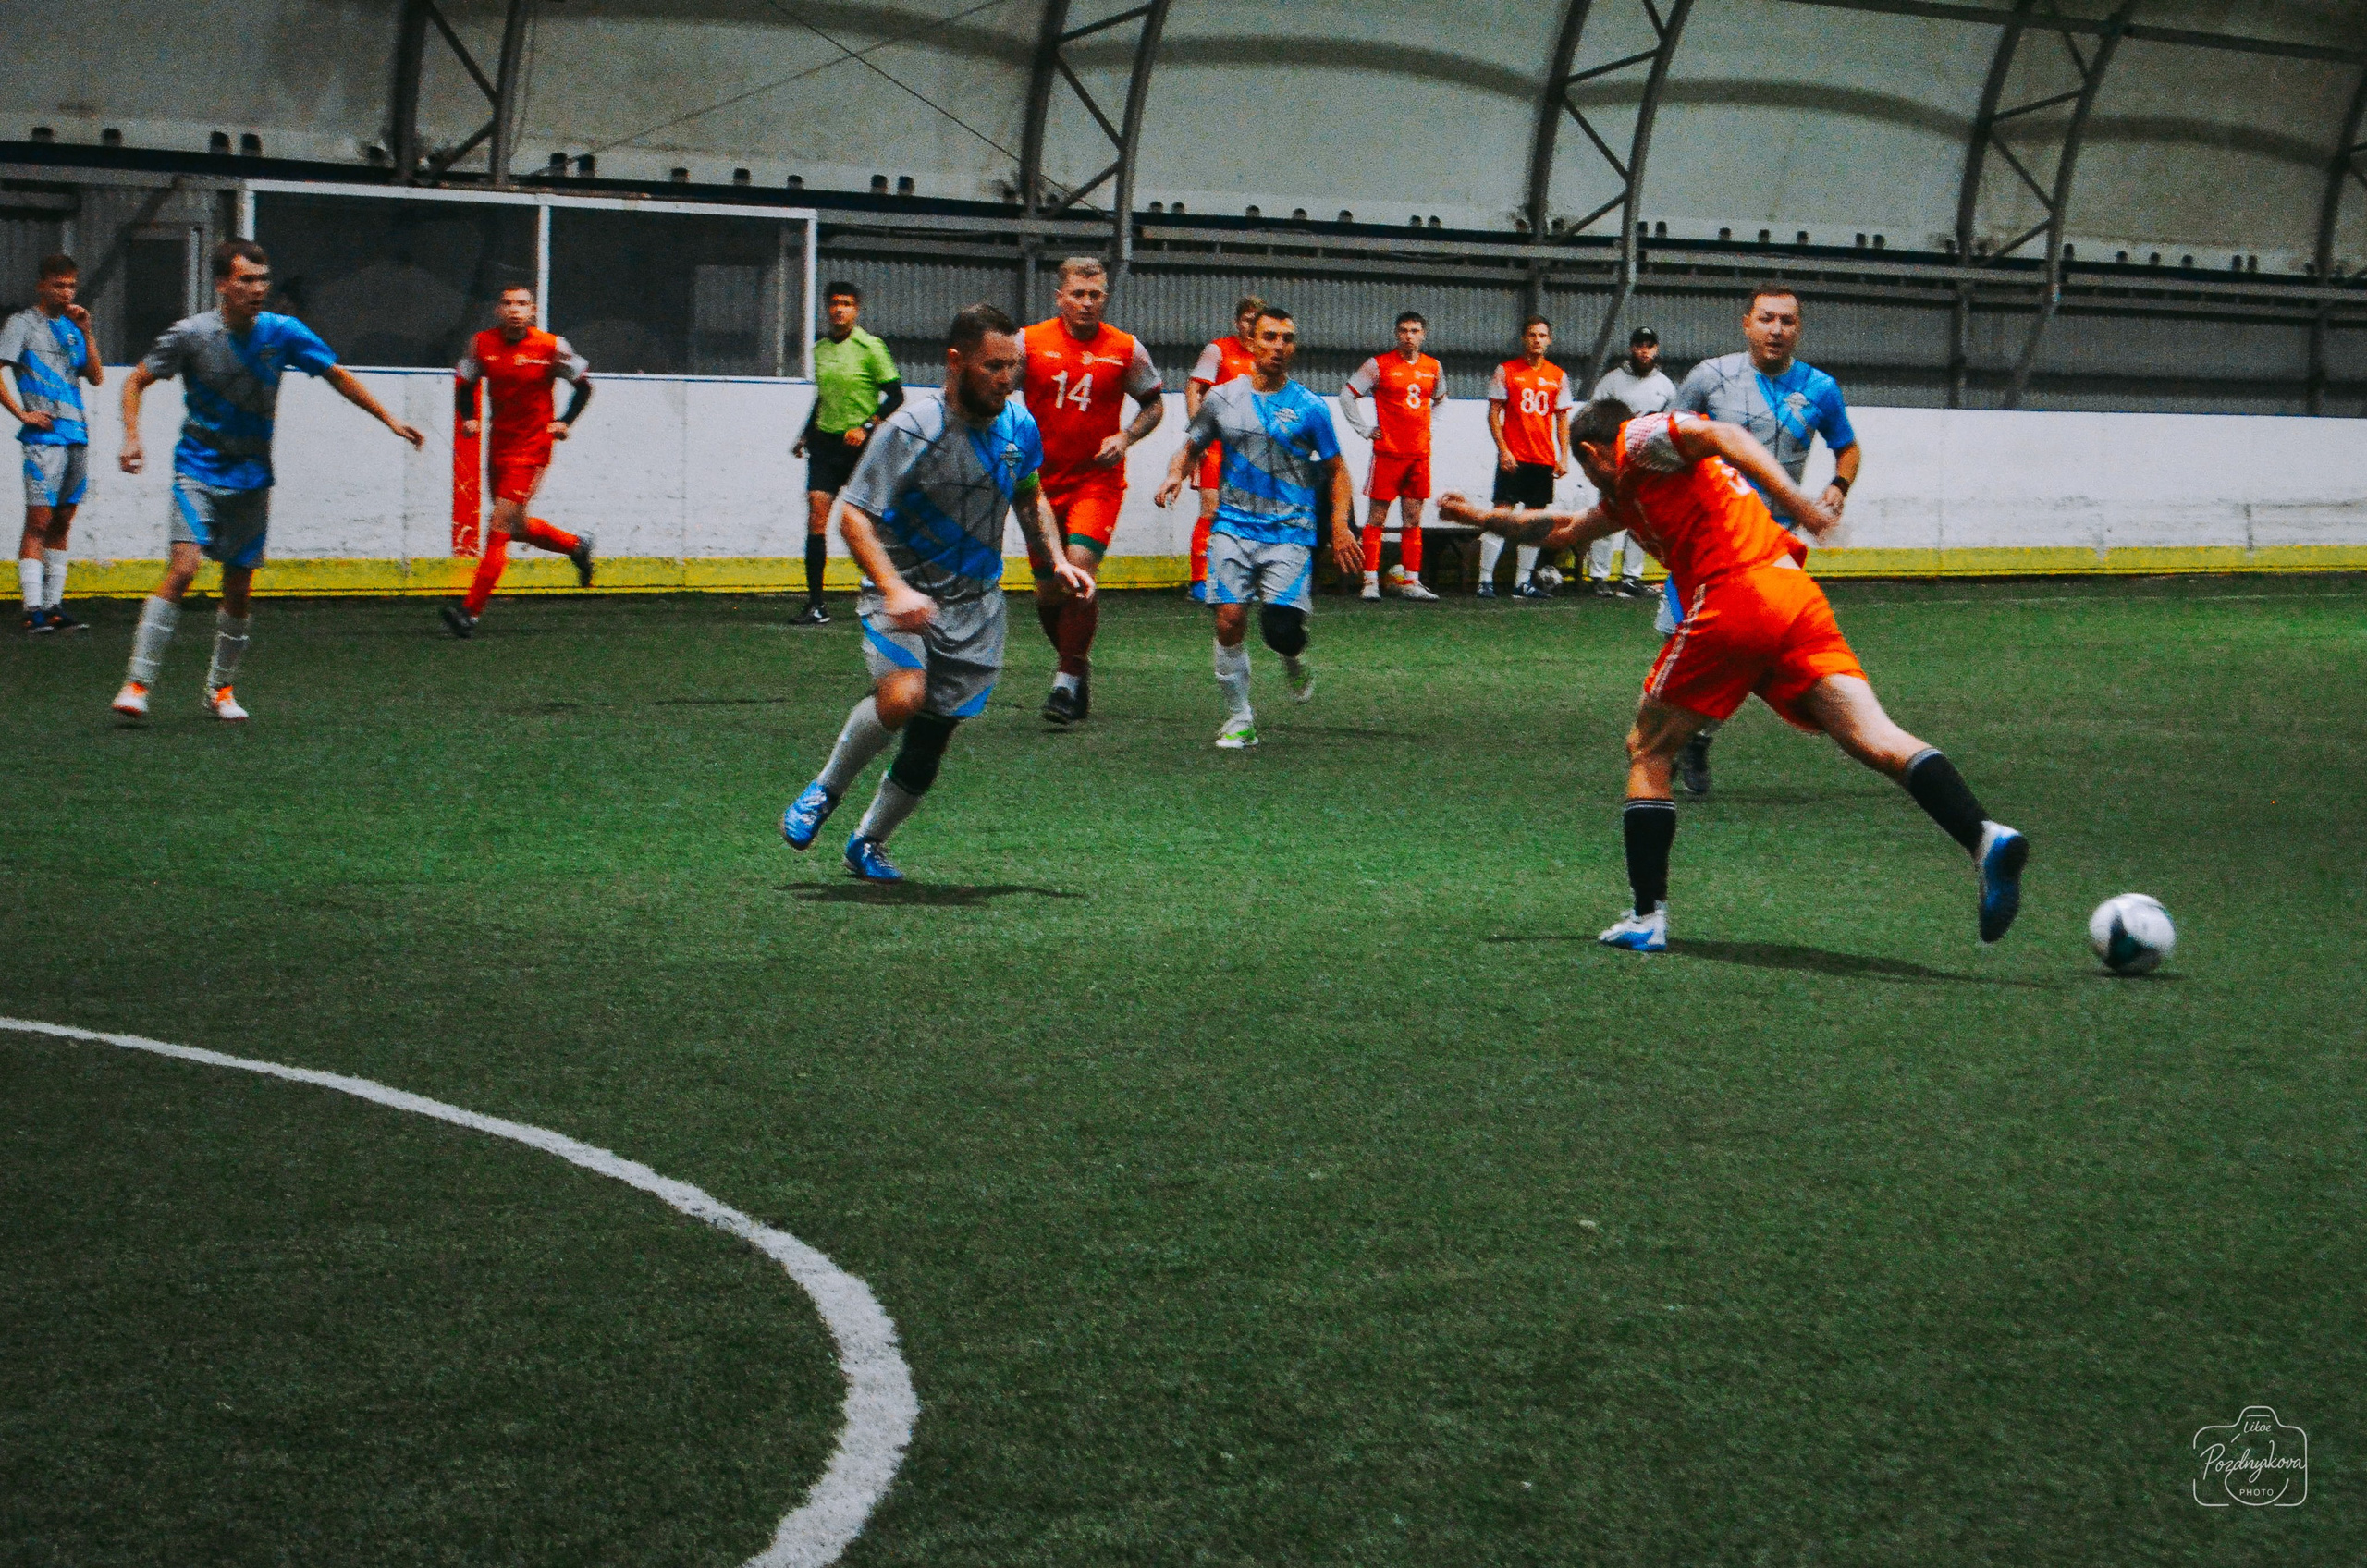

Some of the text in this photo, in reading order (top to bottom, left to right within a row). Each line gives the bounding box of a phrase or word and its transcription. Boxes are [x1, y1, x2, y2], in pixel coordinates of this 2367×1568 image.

[1050, 369, 1094, 412] 14
[1405, 383, 1421, 410] 8
[1520, 387, 1550, 416] 80
